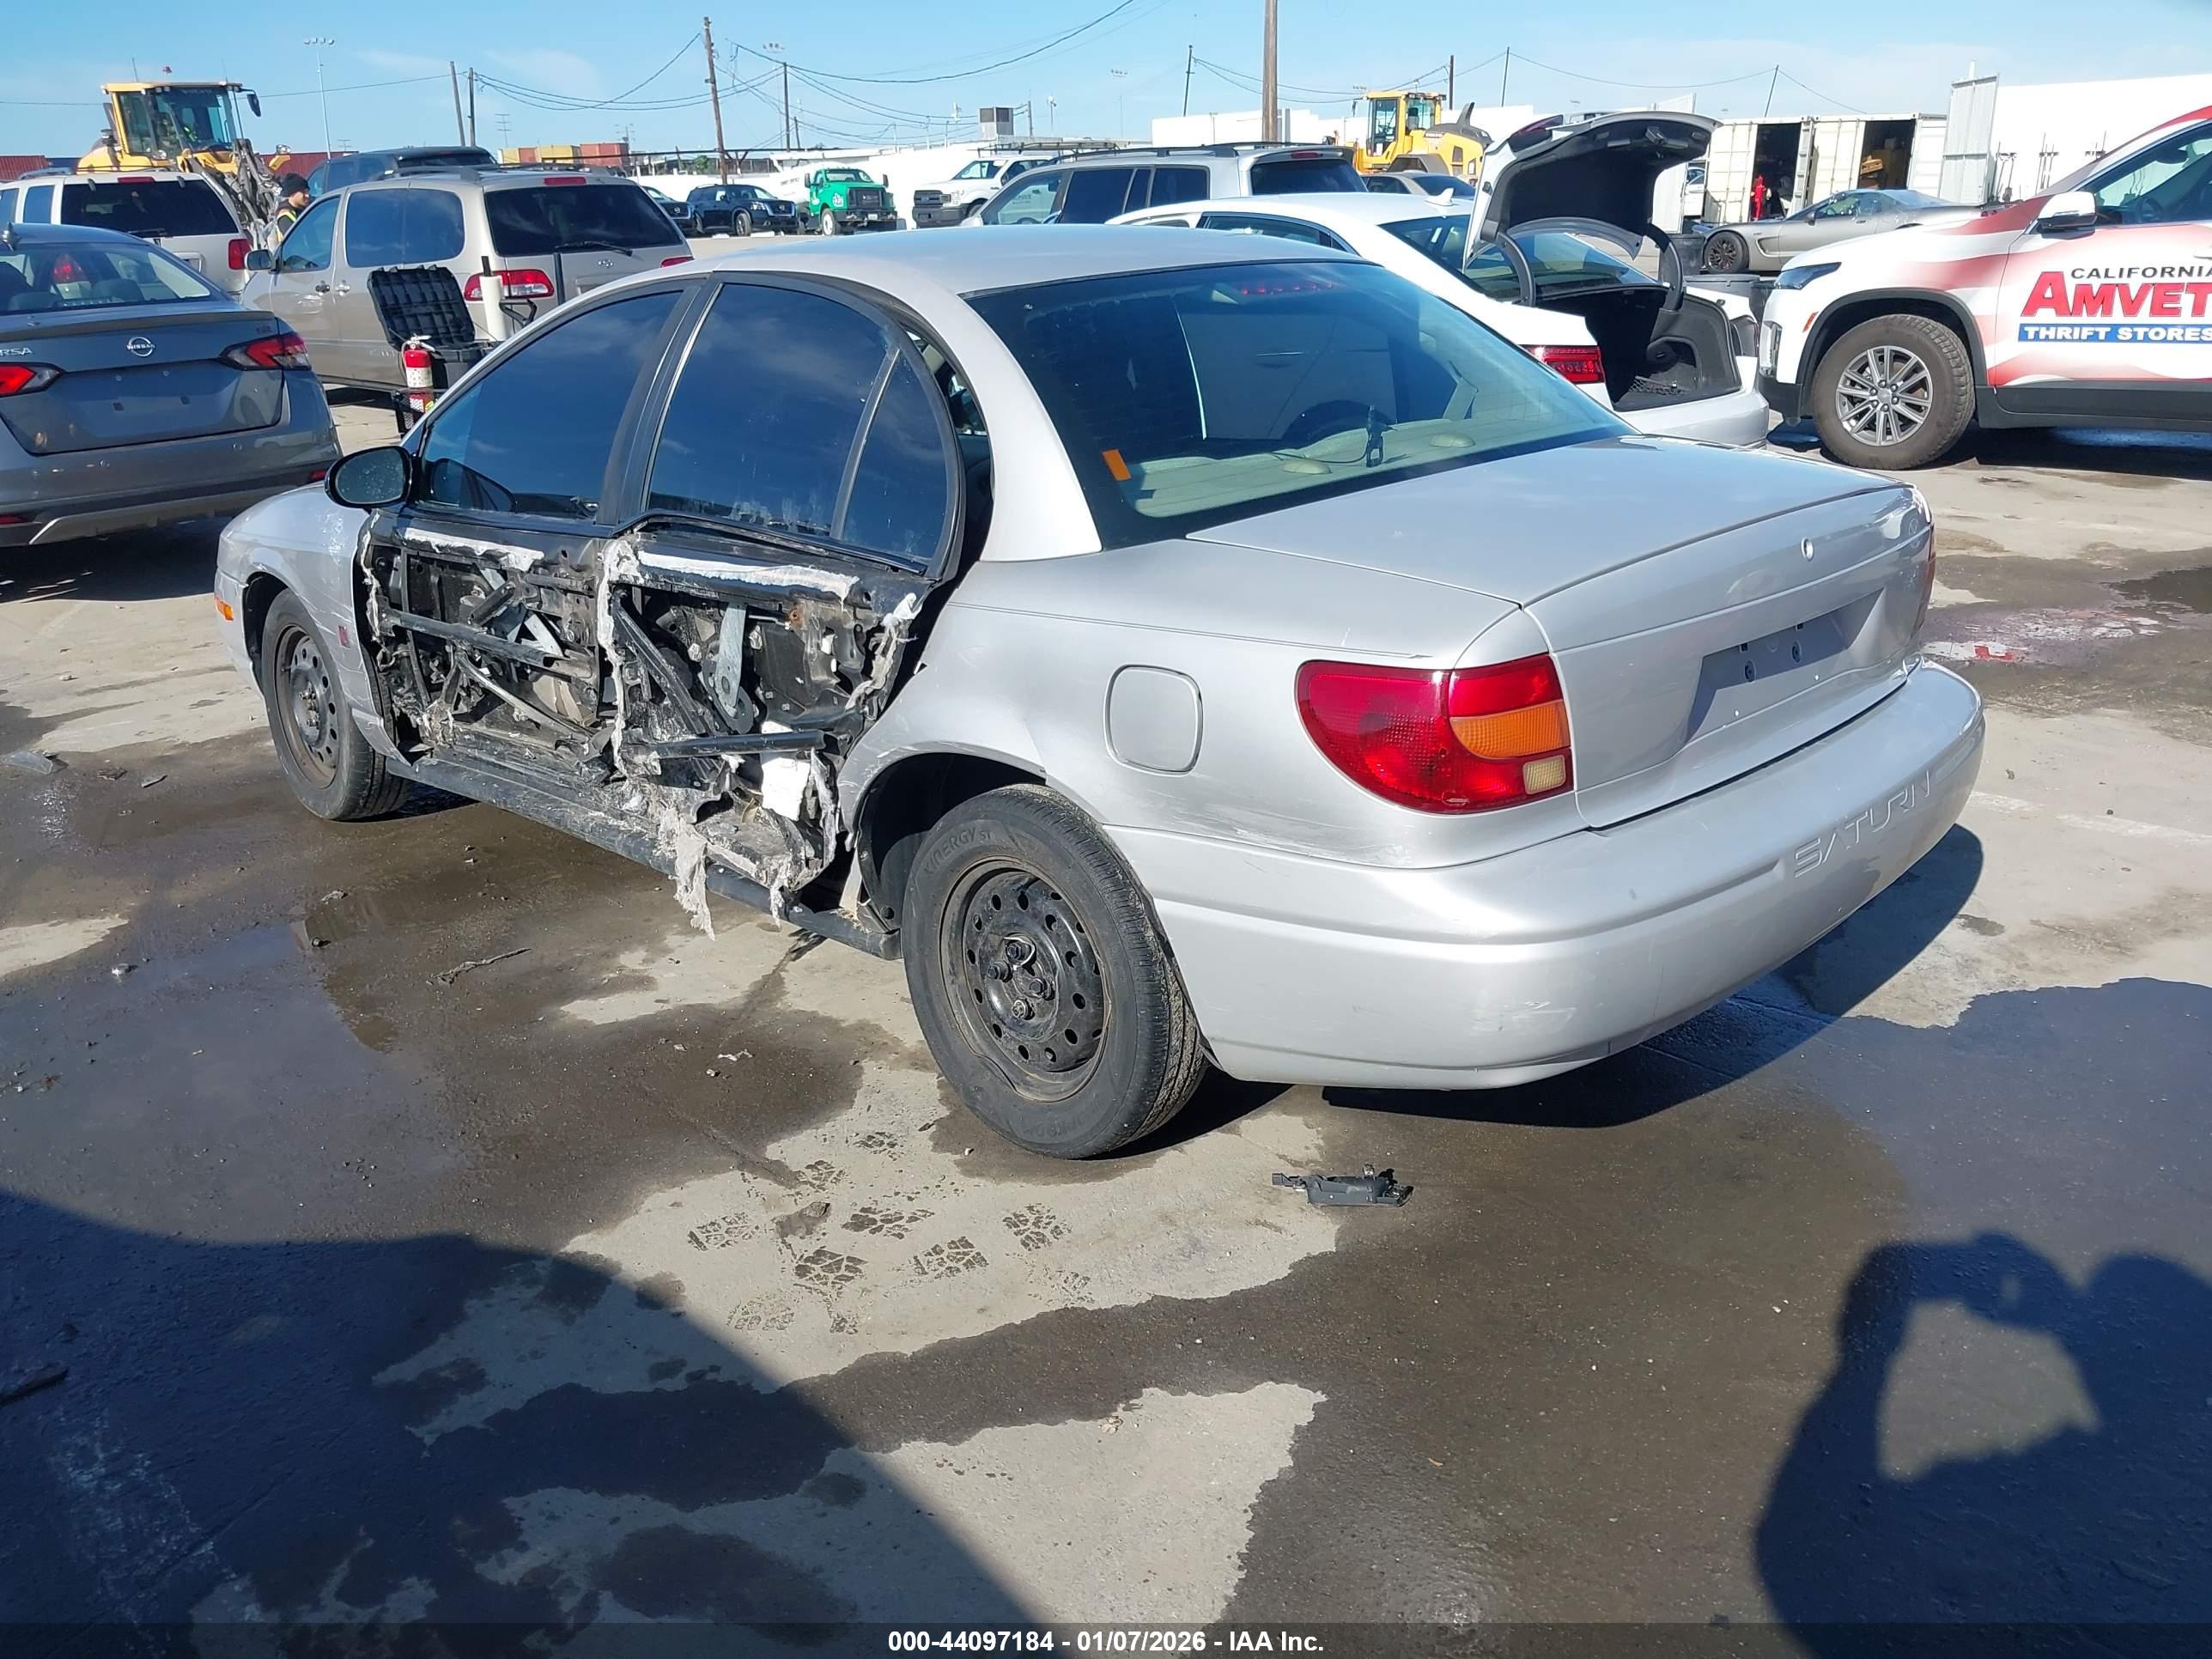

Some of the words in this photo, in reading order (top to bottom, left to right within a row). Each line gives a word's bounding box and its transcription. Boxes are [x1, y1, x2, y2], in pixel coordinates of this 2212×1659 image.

[2020, 270, 2212, 318] AMVET
[2024, 326, 2112, 341] THRIFT
[2116, 327, 2212, 342] STORES
[1794, 769, 1931, 878] SATURN
[924, 826, 977, 873] KINERGY
